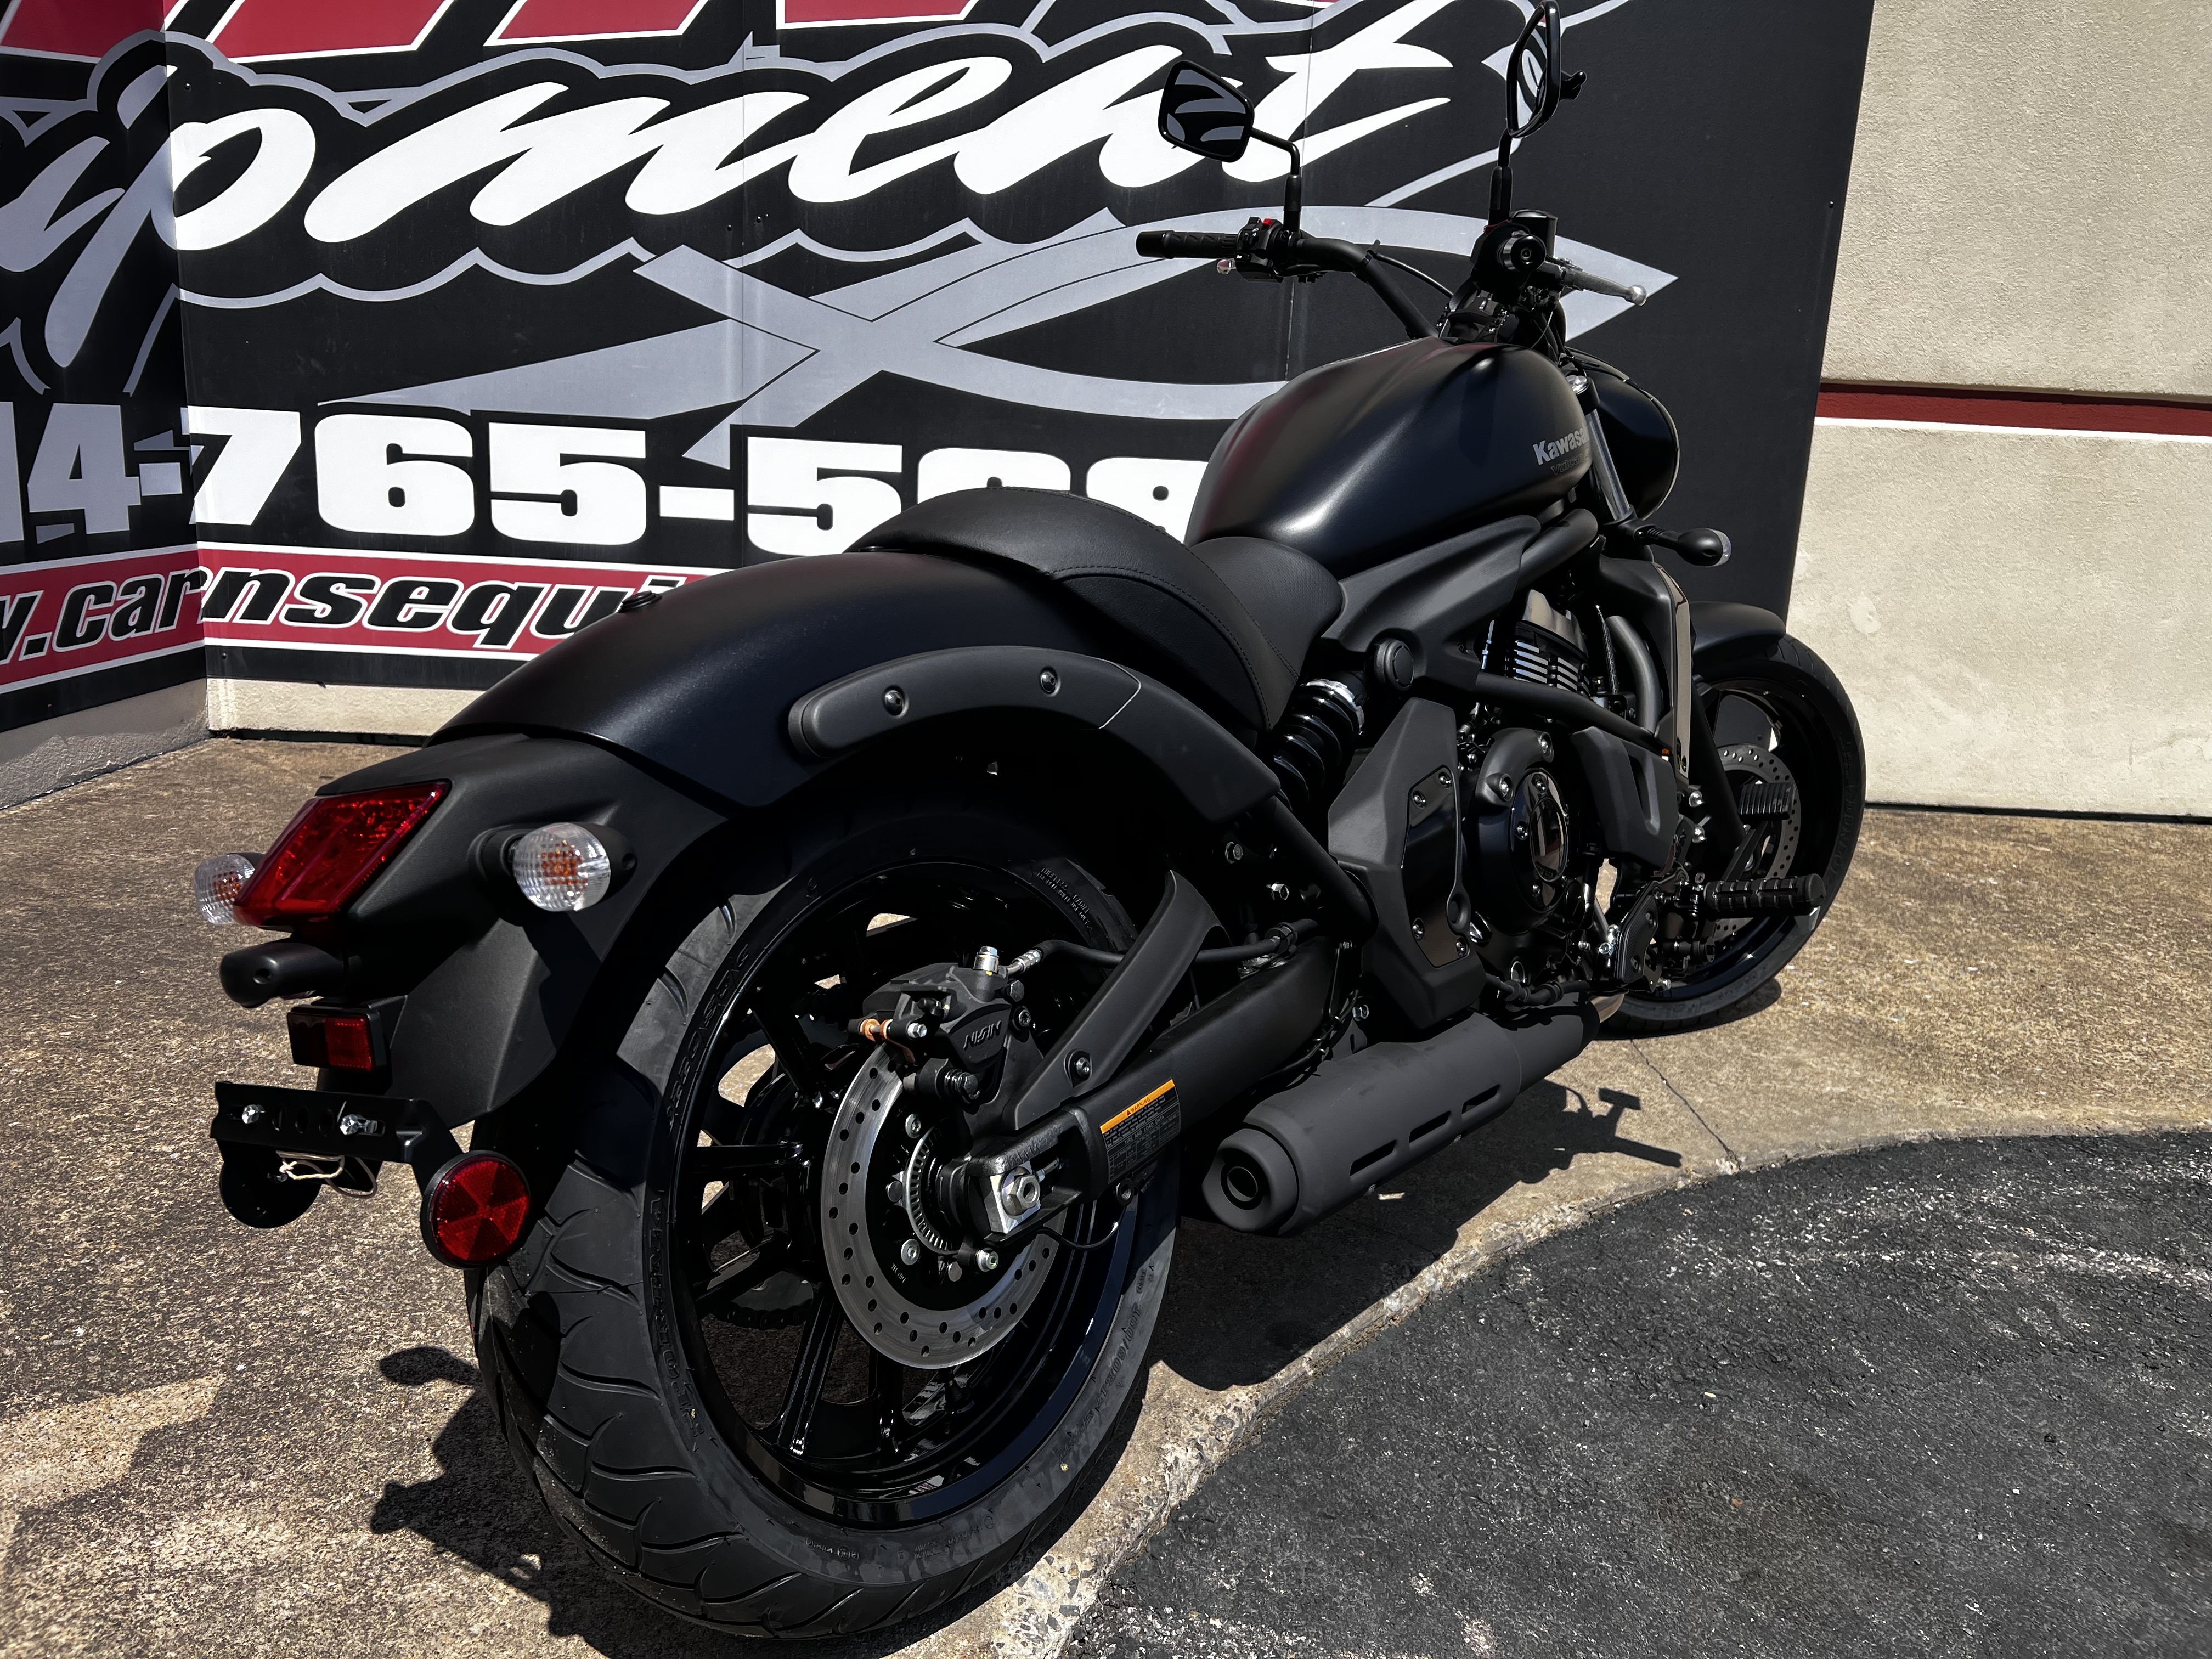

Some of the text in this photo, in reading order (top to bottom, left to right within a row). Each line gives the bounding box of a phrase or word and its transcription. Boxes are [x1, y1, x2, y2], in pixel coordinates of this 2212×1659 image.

[1130, 1097, 1151, 1113] WARNING
[1124, 1115, 1165, 1145] TIRE AND LOAD DATA
